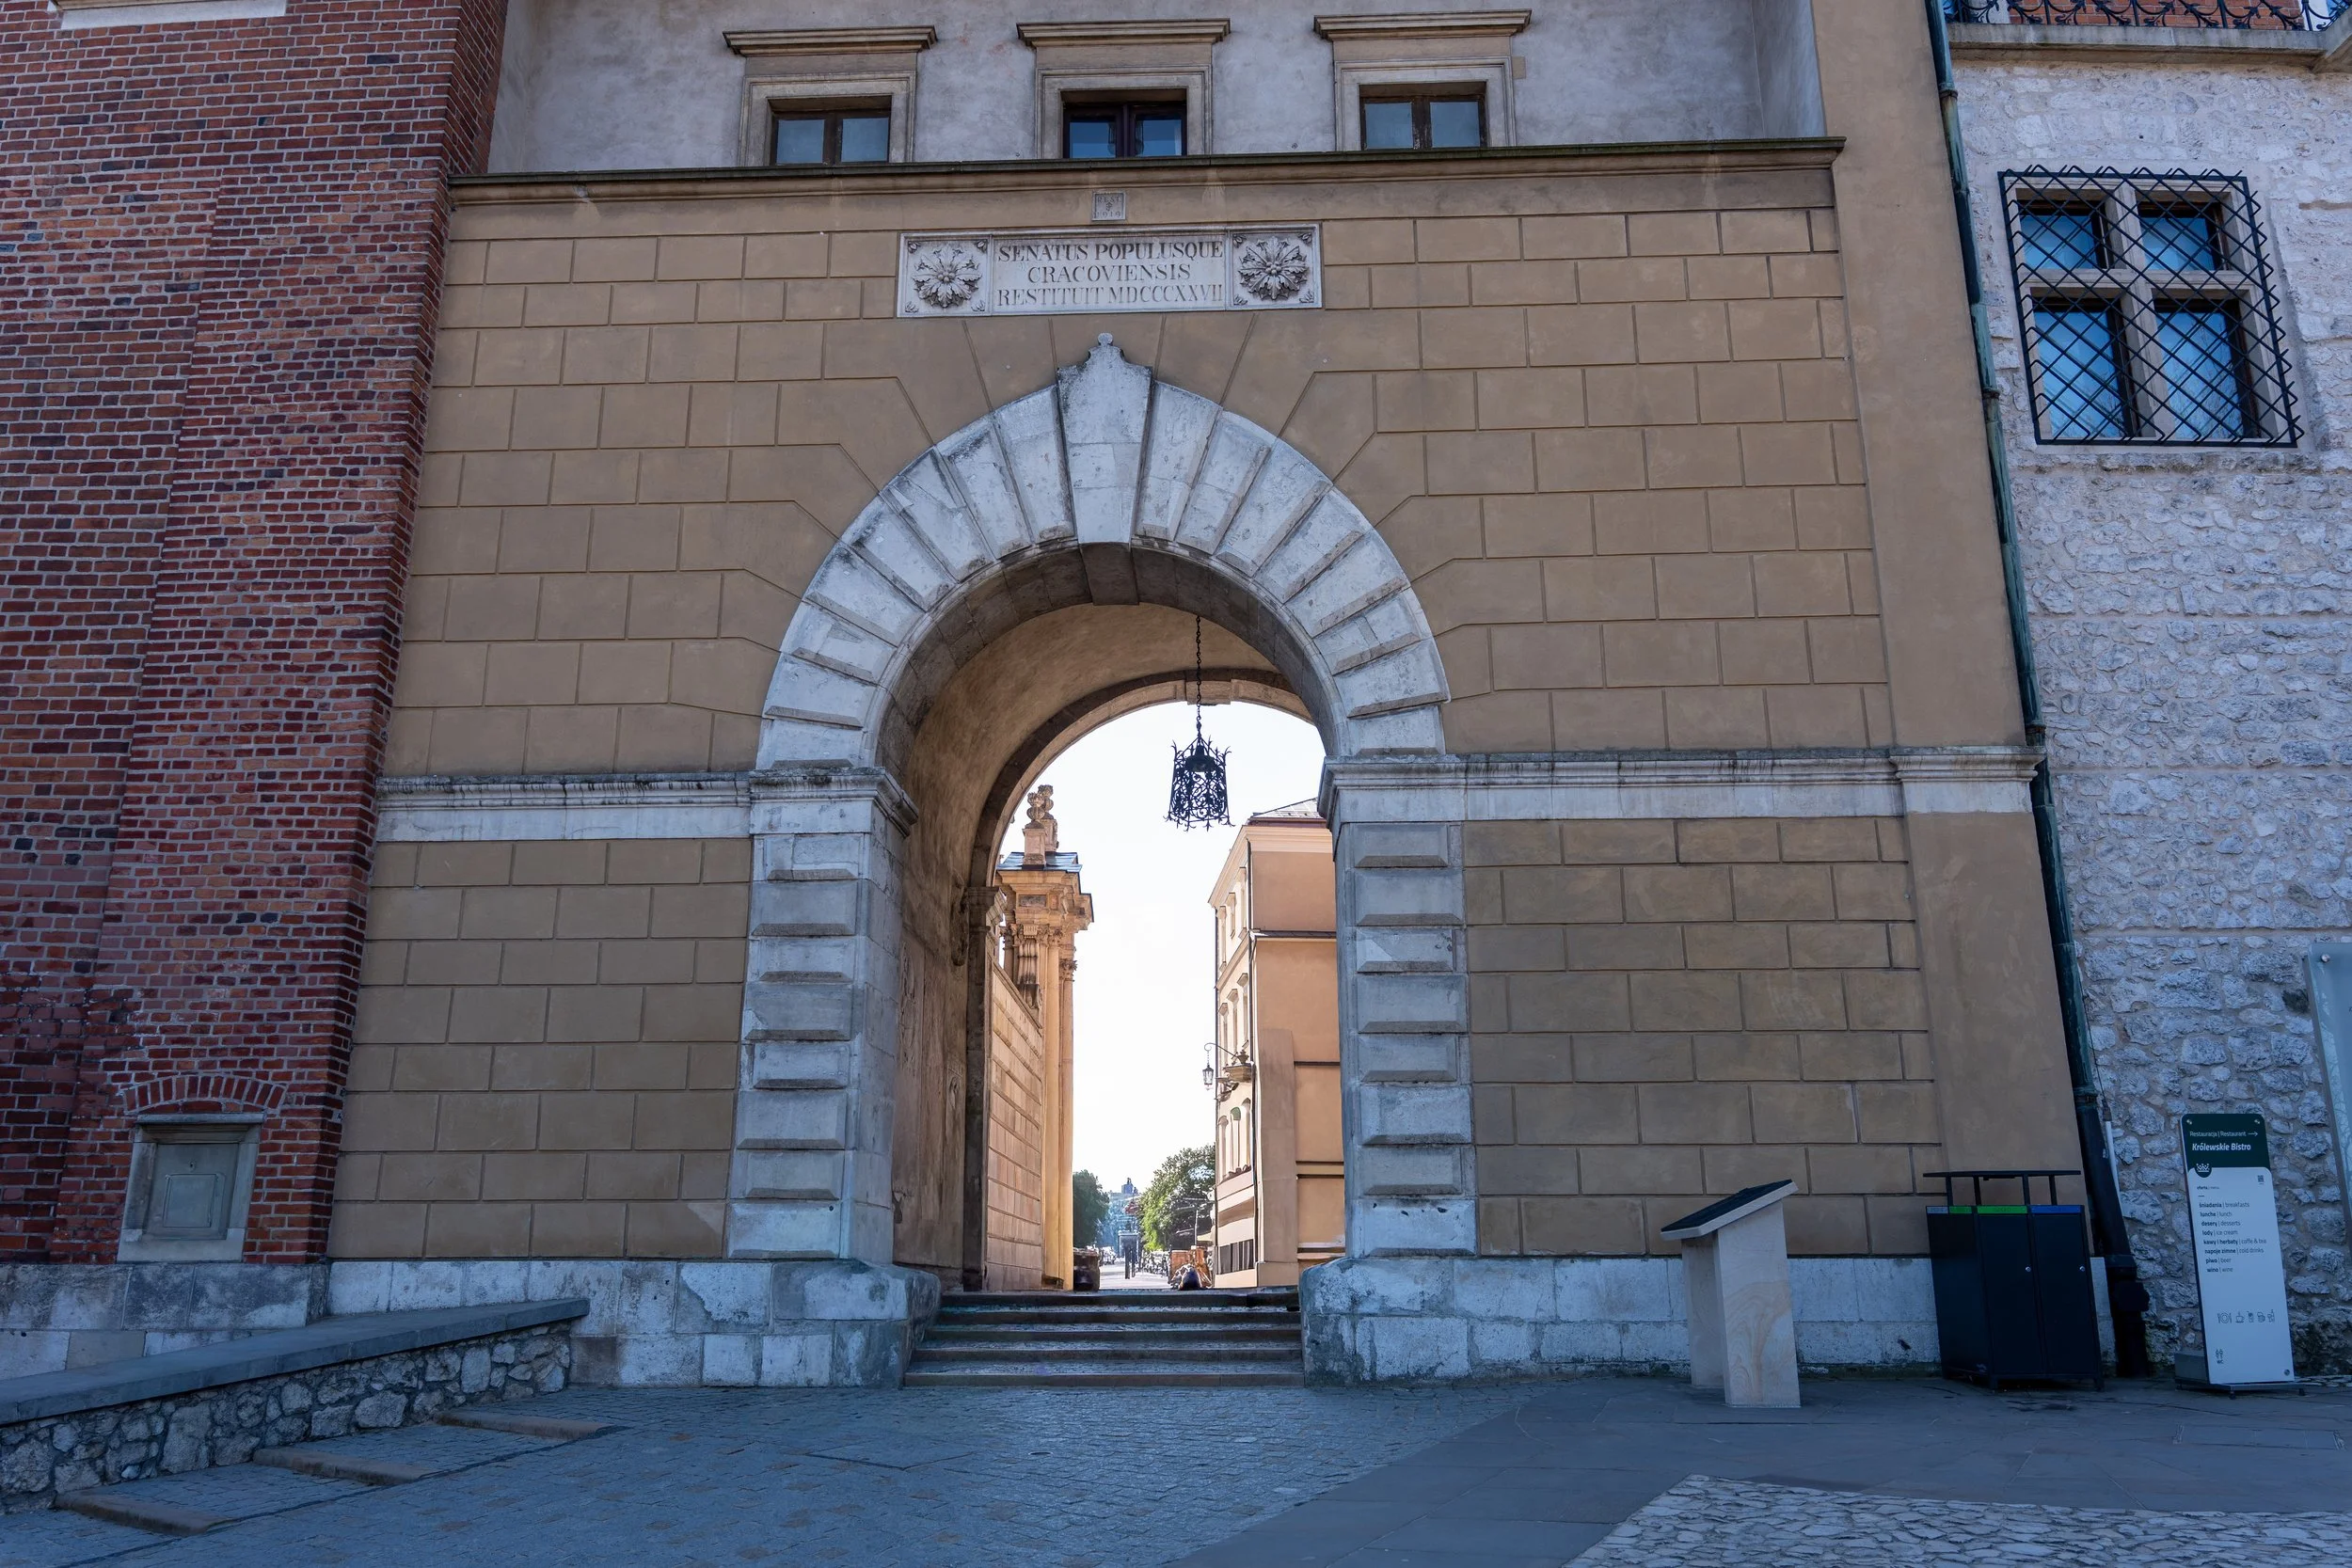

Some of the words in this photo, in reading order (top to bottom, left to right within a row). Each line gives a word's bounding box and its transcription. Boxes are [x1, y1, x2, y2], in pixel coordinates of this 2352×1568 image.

[998, 244, 1089, 261] SENATUS
[1094, 241, 1223, 261] POPULUSQUE
[1027, 263, 1190, 283] CRACOVIENSIS
[997, 287, 1104, 306] RESTITUIT
[1108, 284, 1223, 304] MDCCCXXVII
[2192, 1142, 2230, 1151] Królewskie
